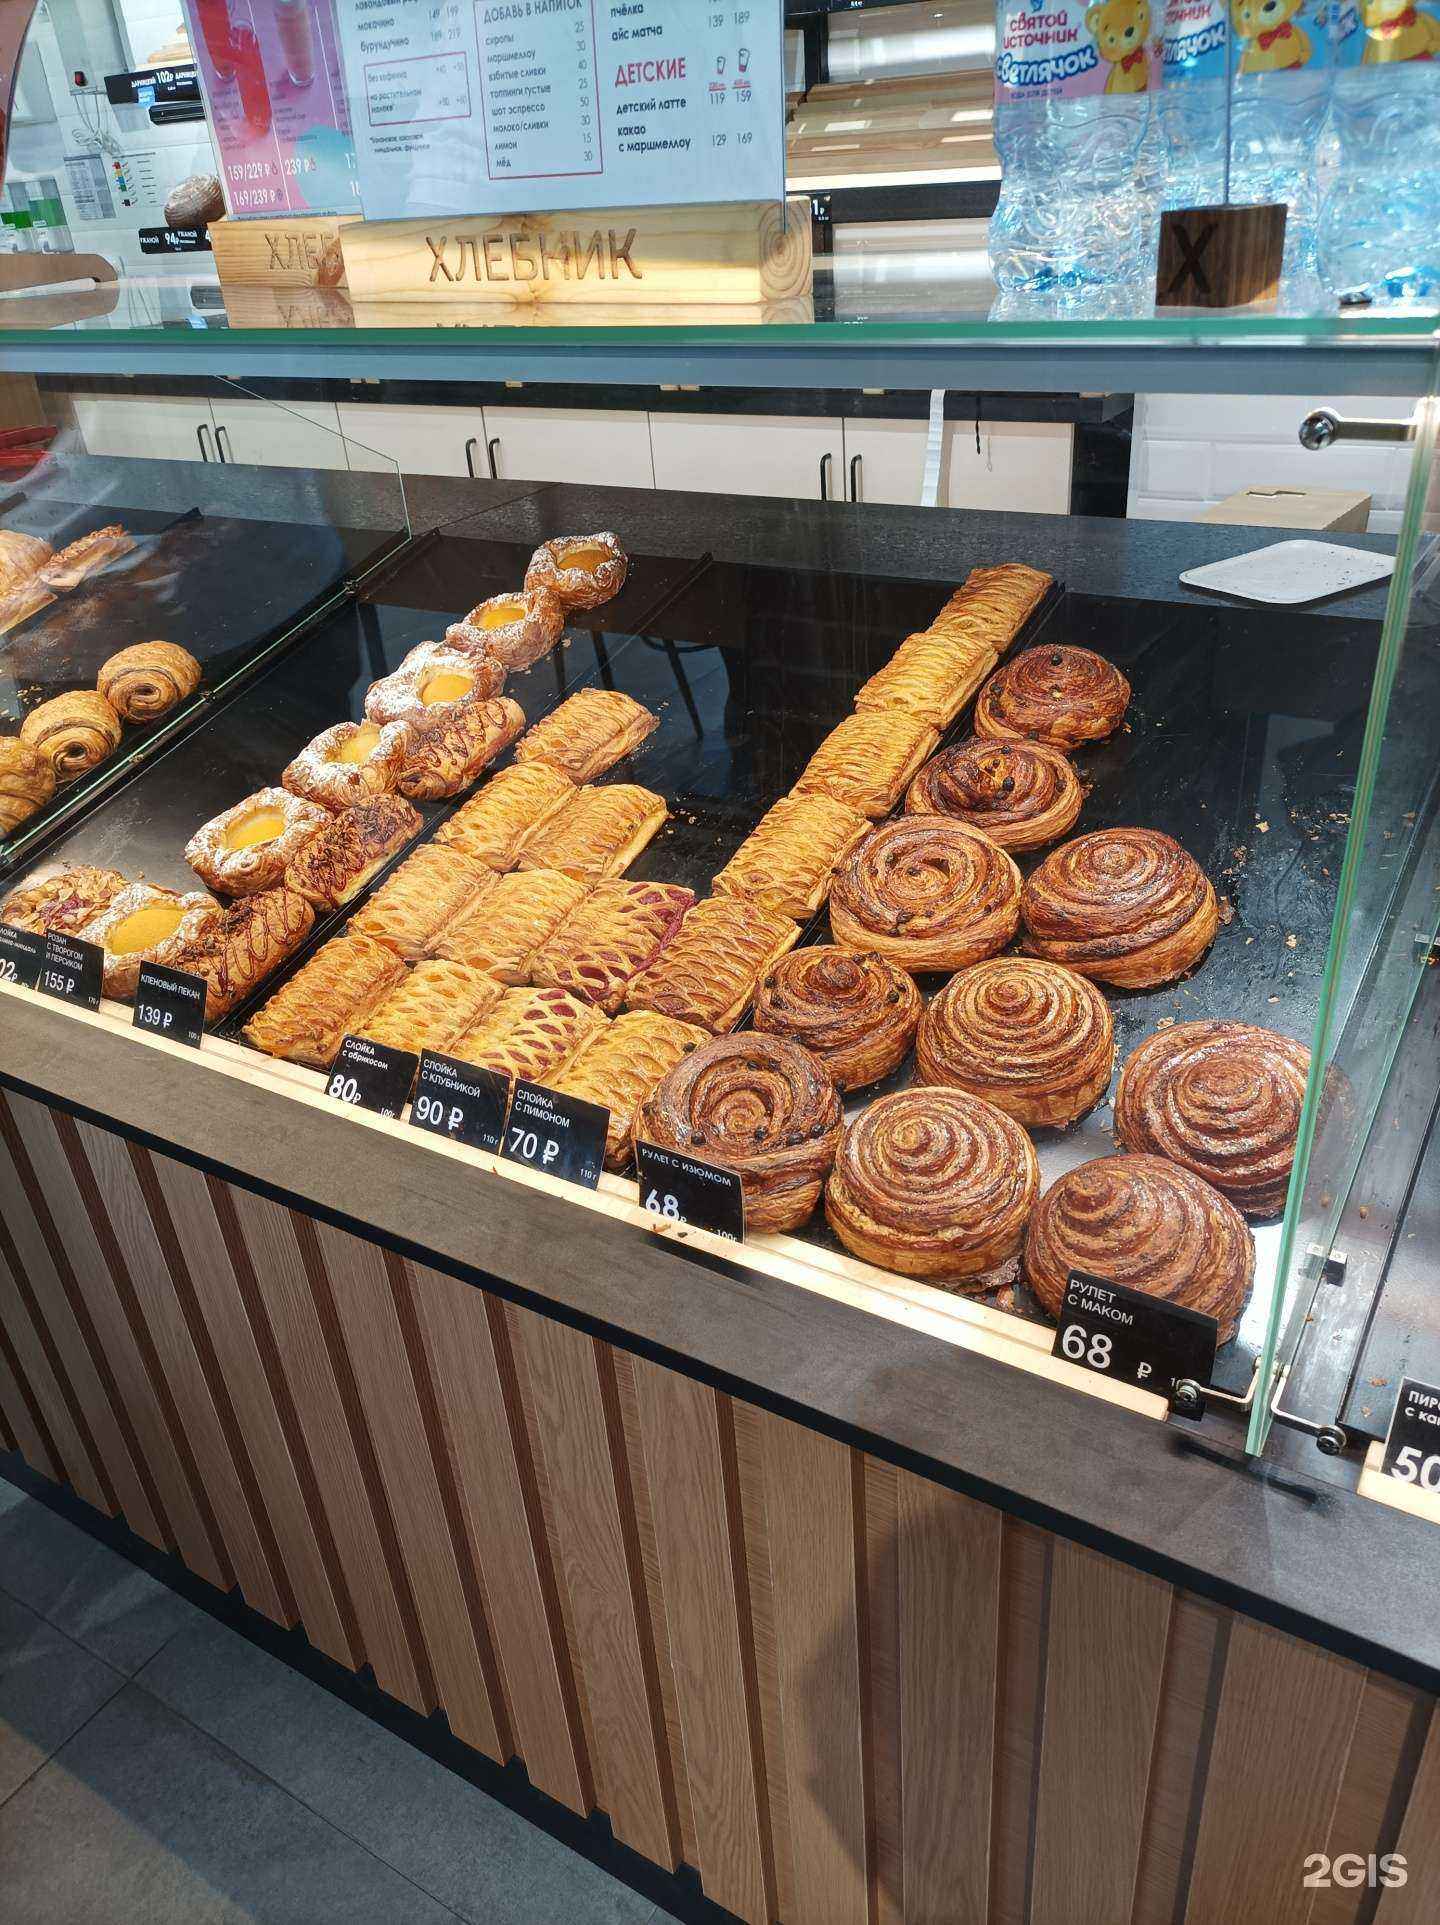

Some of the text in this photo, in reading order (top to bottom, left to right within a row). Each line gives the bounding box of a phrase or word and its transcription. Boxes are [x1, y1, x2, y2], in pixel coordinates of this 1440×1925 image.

[484, 5, 523, 24] ДОБАВЬ
[526, 2, 532, 16] В
[610, 3, 644, 18] пчёлка
[612, 11, 750, 41] айс матча 139 189
[487, 49, 536, 64] маршмеллоу
[520, 67, 546, 78] сливки
[615, 57, 686, 88] ДЕТСКИЕ
[508, 104, 546, 117] эспрессо
[616, 90, 751, 115] детский латте 119 159
[581, 115, 591, 126] 30
[618, 125, 646, 137] какао
[495, 142, 517, 151] лимон
[619, 132, 752, 154] с маршмеллоу 129 169
[497, 151, 593, 168] мёд 30
[425, 228, 642, 282] ХЛЕБНИК
[0, 927, 17, 939] ЛОЙКА
[48, 933, 67, 946] РОЗАН
[45, 952, 83, 971] И ПЕРСИКОМ
[47, 943, 83, 961] С ТВОРОГОМ
[44, 971, 64, 992] 155
[140, 973, 200, 1000] КЛЕНОВЫЙ ПЕКАН
[138, 1004, 161, 1026] 139
[345, 1040, 375, 1056] СЛОЙКА
[348, 1051, 389, 1070] абрикосом
[423, 1058, 458, 1078] СЛОЙКА
[421, 1070, 481, 1098] С КЛУБНИКОЙ
[516, 1089, 554, 1110] СЛОЙКА
[415, 1095, 464, 1130] 90 ₽
[515, 1101, 571, 1128] С ЛИМОНОМ
[482, 1133, 495, 1144] 110
[509, 1127, 560, 1164] 70 ₽
[580, 1168, 592, 1180] 110
[642, 1147, 732, 1188] РУЛЕТ С ИЗЮМОМ
[1069, 1279, 1116, 1303] РУЛЕТ
[1067, 1293, 1134, 1326] С МАКОМ
[1062, 1324, 1152, 1379] 68 ₽
[1409, 1390, 1440, 1411] ПИР
[1404, 1407, 1415, 1417] с
[1391, 1446, 1440, 1494] 50
